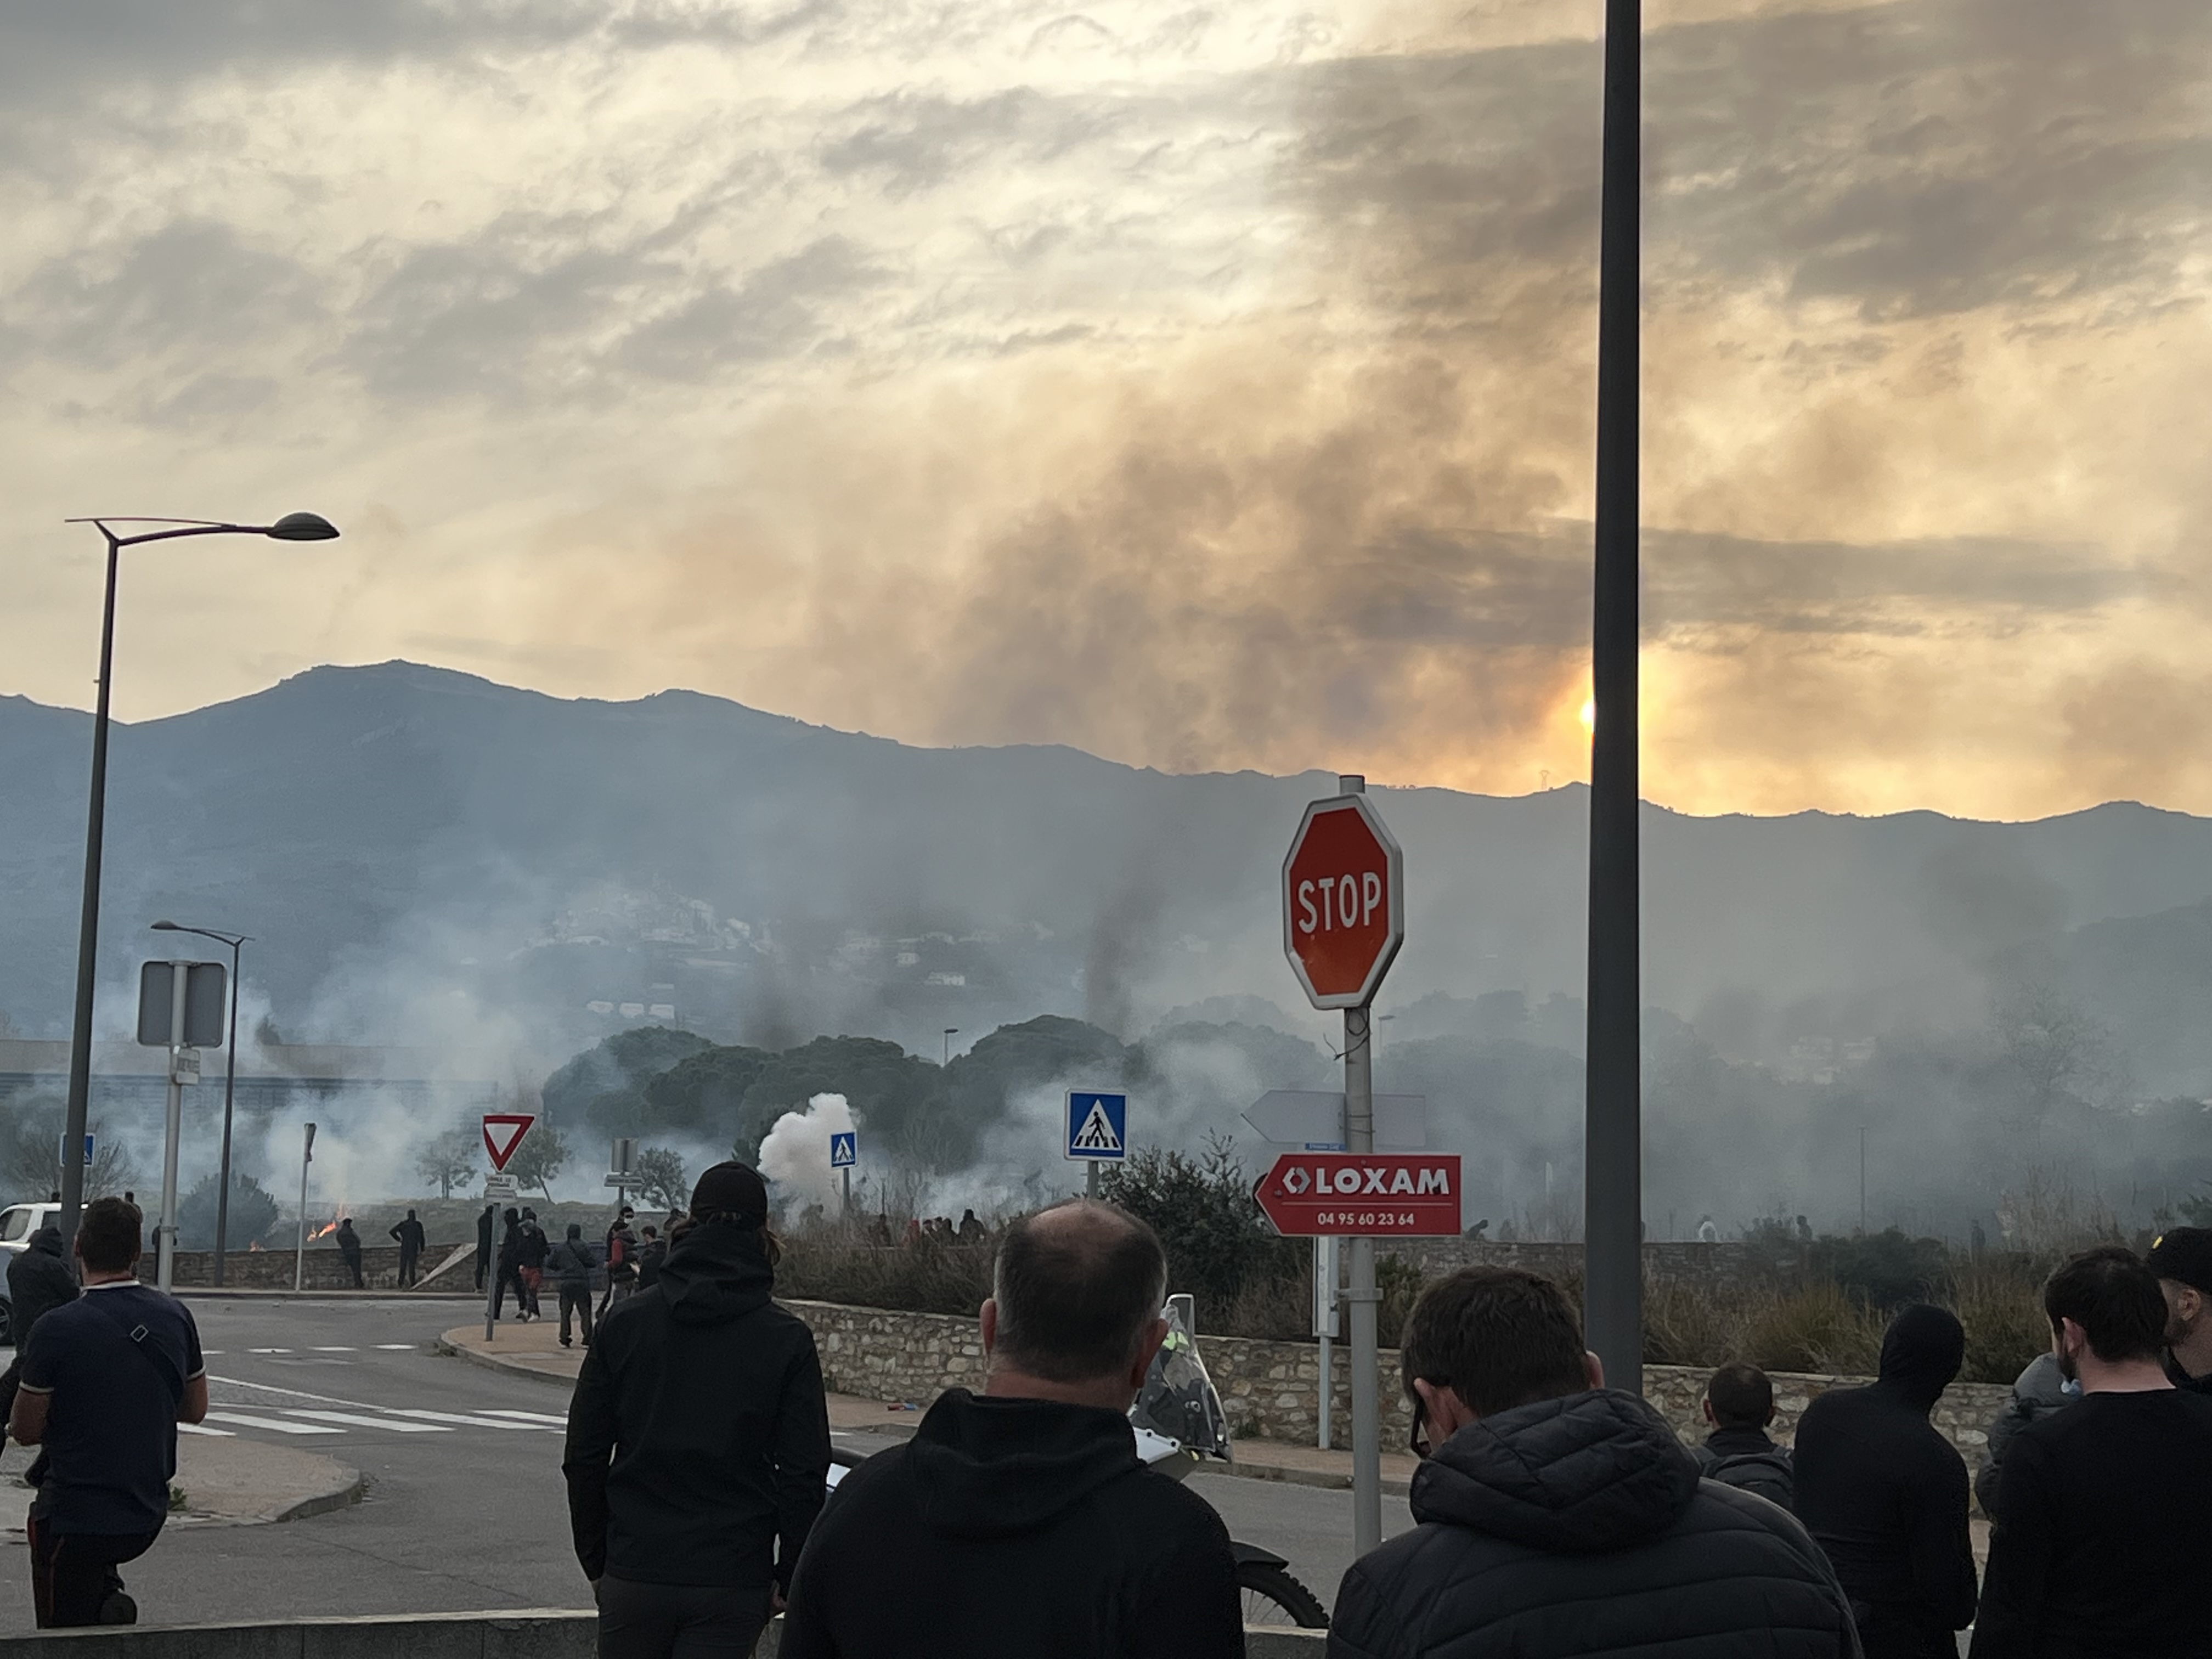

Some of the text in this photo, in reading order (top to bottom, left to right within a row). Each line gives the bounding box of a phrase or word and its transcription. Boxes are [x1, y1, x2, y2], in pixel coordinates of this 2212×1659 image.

[1298, 871, 1381, 933] STOP
[1316, 1167, 1449, 1195] LOXAM
[1318, 1212, 1414, 1226] 04 95 60 23 64
